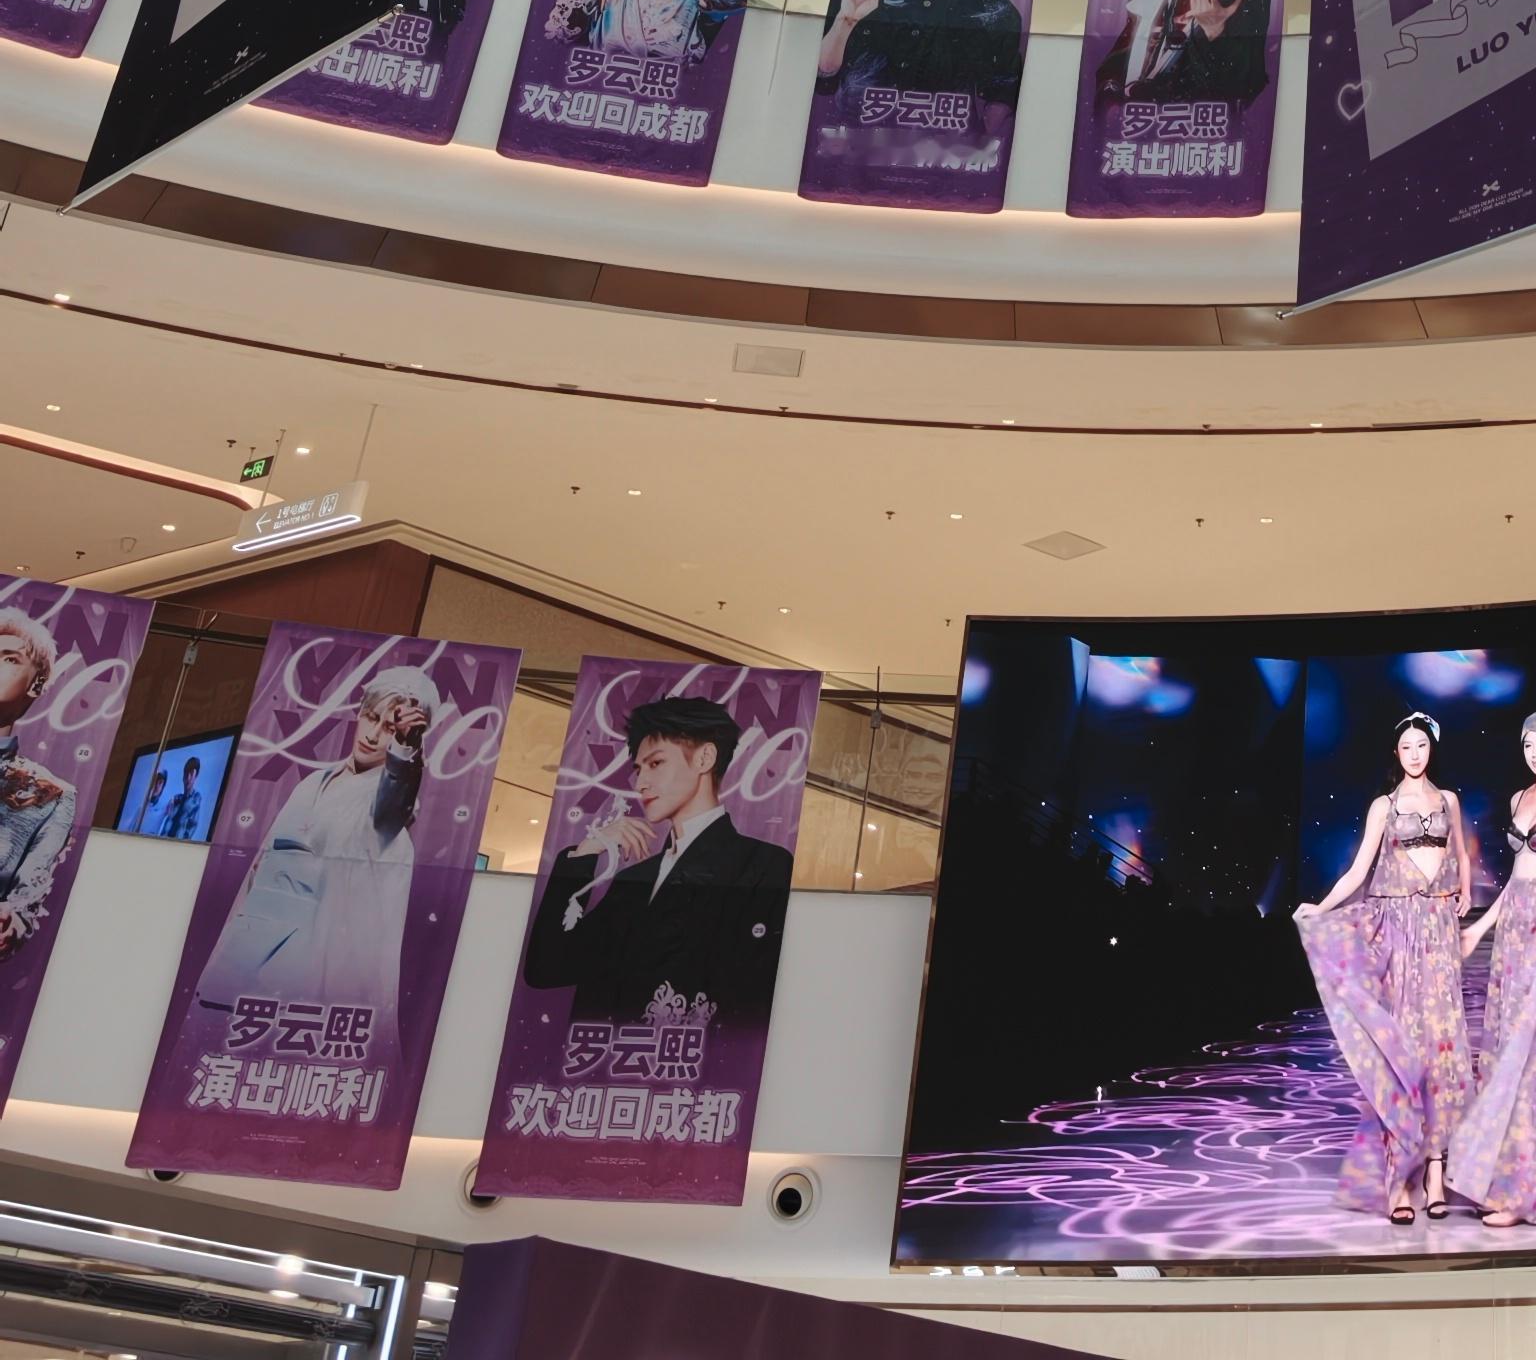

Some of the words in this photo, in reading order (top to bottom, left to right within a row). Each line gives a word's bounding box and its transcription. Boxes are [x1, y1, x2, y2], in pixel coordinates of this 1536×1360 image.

[312, 44, 440, 98] 出顺利
[566, 48, 680, 100] 罗云熙
[1456, 31, 1509, 74] LUO
[519, 84, 709, 144] 欢迎回成都
[859, 87, 970, 130] 罗云熙
[1121, 102, 1228, 139] 罗云熙
[1101, 141, 1243, 177] 演出顺利
[227, 996, 374, 1060] 罗云熙
[563, 1023, 704, 1080] 罗云熙
[187, 1053, 385, 1123] 演出顺利
[505, 1084, 741, 1144] 欢迎回成都
